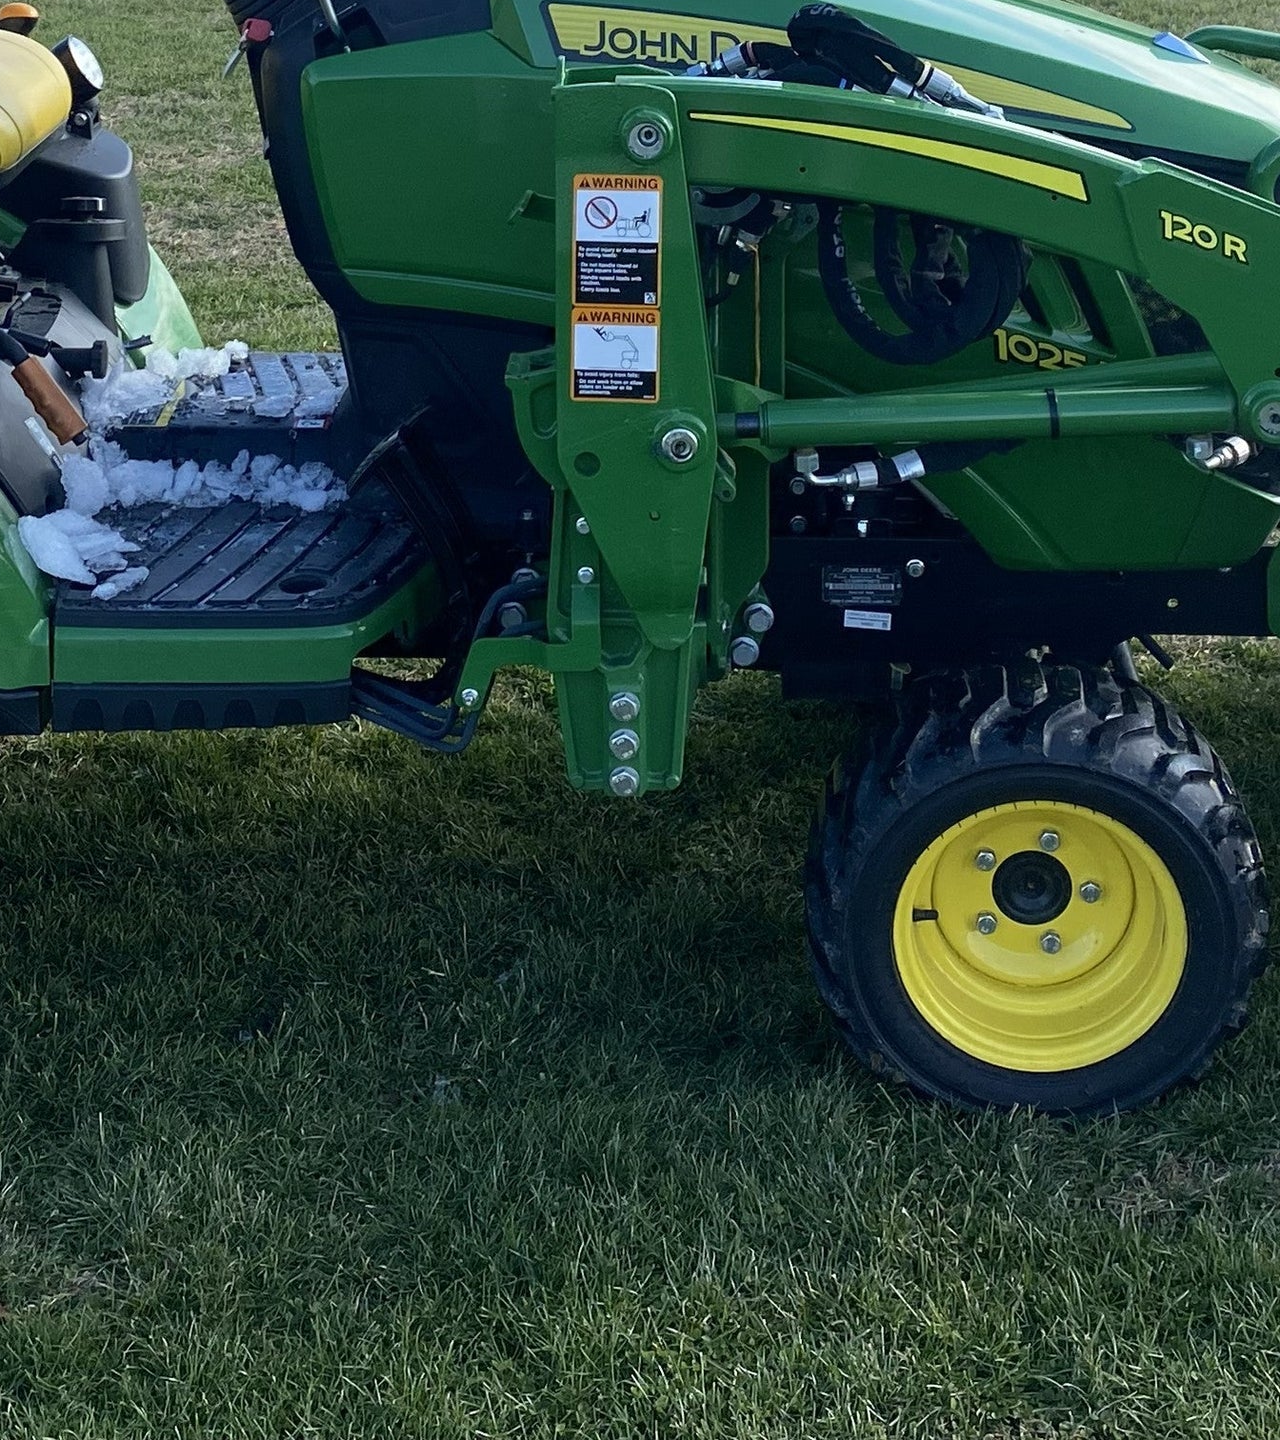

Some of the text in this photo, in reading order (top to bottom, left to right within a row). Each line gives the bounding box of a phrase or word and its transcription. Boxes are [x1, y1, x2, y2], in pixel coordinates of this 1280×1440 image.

[584, 20, 697, 61] JOHN
[592, 177, 658, 189] WARNING
[1160, 210, 1247, 262] 120 R
[590, 311, 656, 323] WARNING
